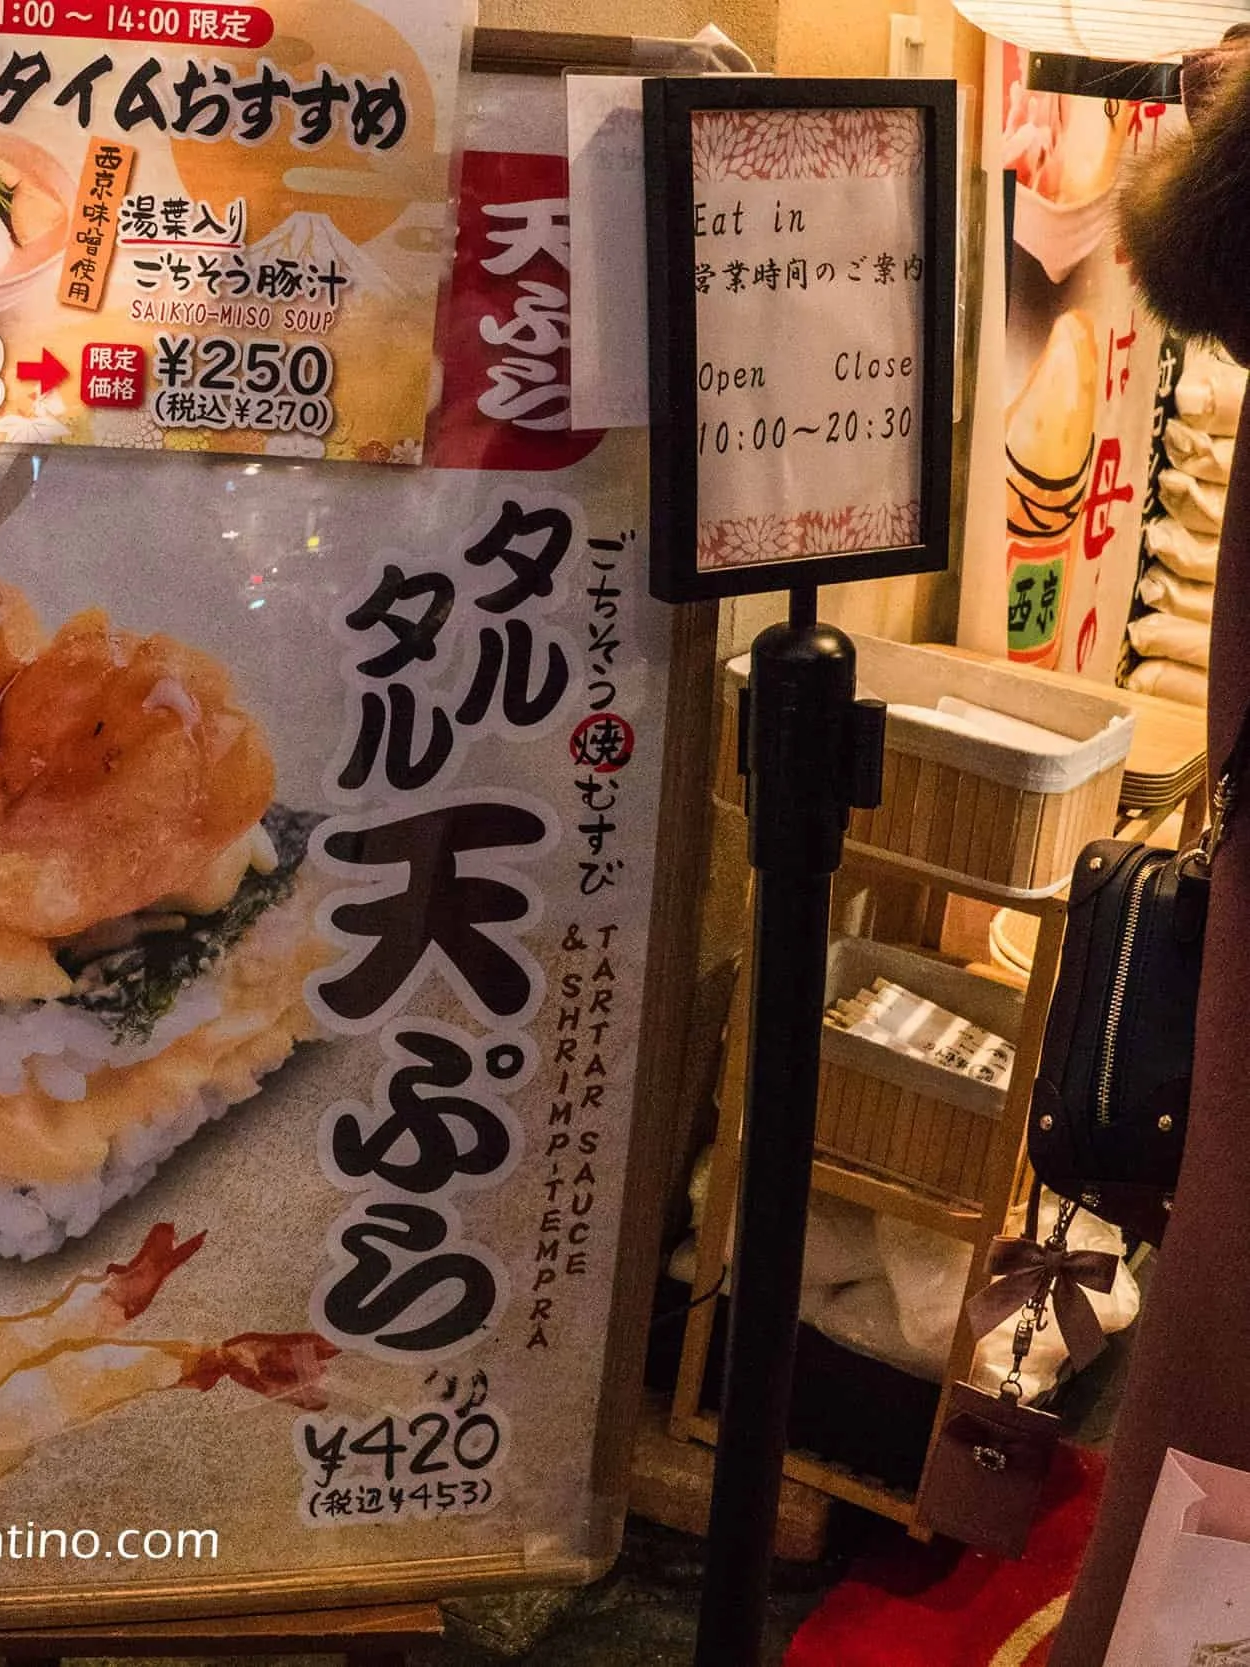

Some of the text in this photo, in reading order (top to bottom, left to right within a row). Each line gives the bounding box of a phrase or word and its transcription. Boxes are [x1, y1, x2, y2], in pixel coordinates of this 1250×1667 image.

[106, 7, 180, 36] 14:00
[188, 10, 252, 42] 限定
[67, 145, 123, 304] 西京味噌使用
[121, 194, 244, 243] 湯葉入り
[694, 200, 806, 237] Eat in
[133, 252, 348, 307] ごちそう豚汁
[695, 252, 924, 295] 営業時間のご案内
[131, 300, 334, 332] SAIKYO-MISO SOUP
[89, 346, 138, 373] 限定
[157, 337, 328, 395] ¥250
[699, 350, 913, 396] Open Close
[87, 375, 137, 402] 価格
[455, 500, 572, 727] タル
[1008, 568, 1058, 634] 西京
[338, 564, 455, 791] タル
[570, 529, 635, 895] ごちそう焼むすび
[562, 925, 588, 950] &
[318, 803, 546, 1352] 天ぷら
[566, 924, 618, 1276] TARTAR SAUCE
[305, 1412, 500, 1488] ¥420
